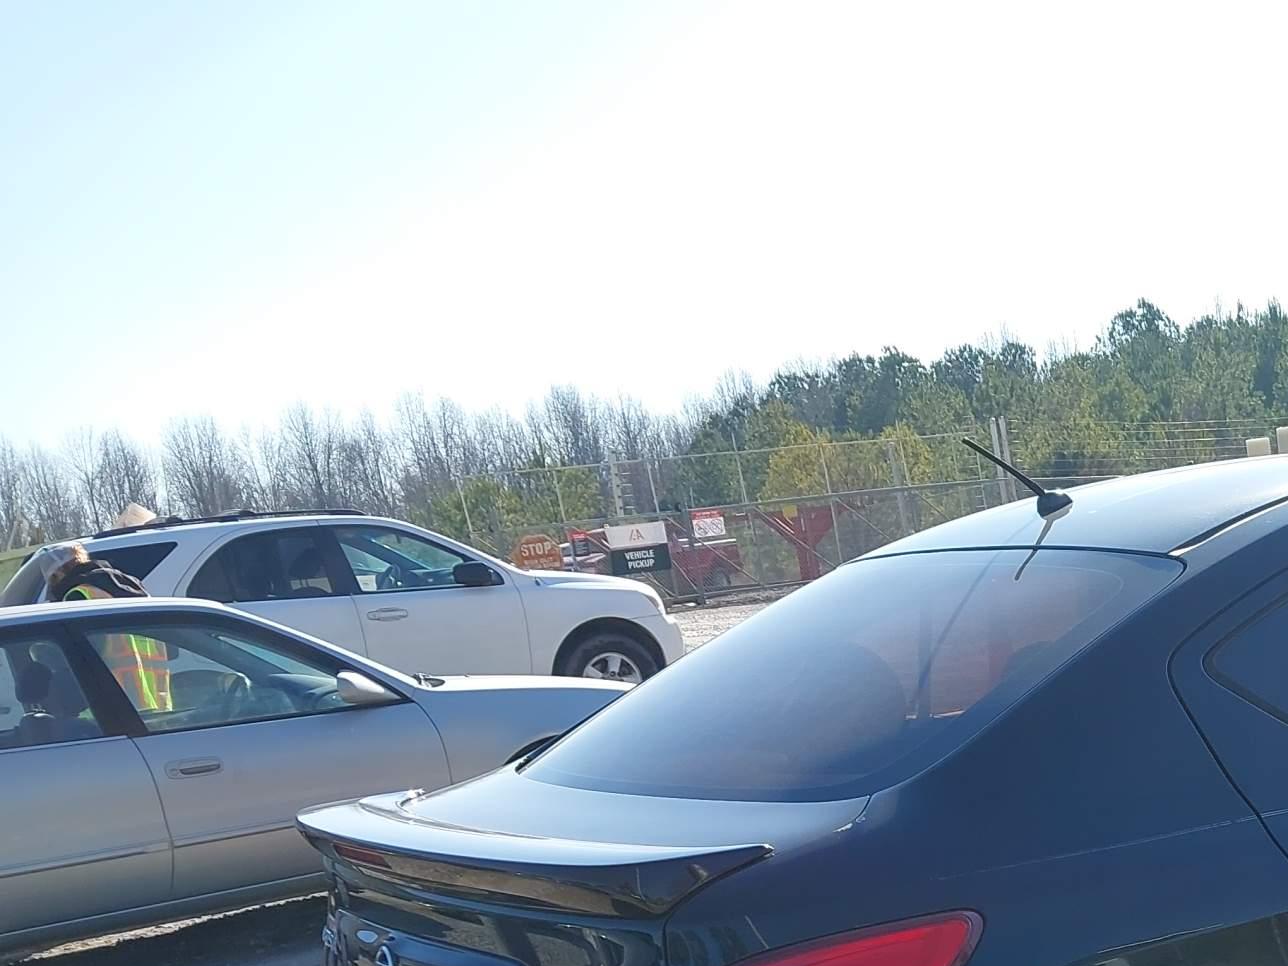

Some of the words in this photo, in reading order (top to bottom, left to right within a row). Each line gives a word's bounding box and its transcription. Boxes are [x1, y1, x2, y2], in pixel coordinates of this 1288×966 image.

[520, 541, 552, 557] STOP
[624, 549, 656, 561] VEHICLE
[627, 558, 655, 570] PICKUP
